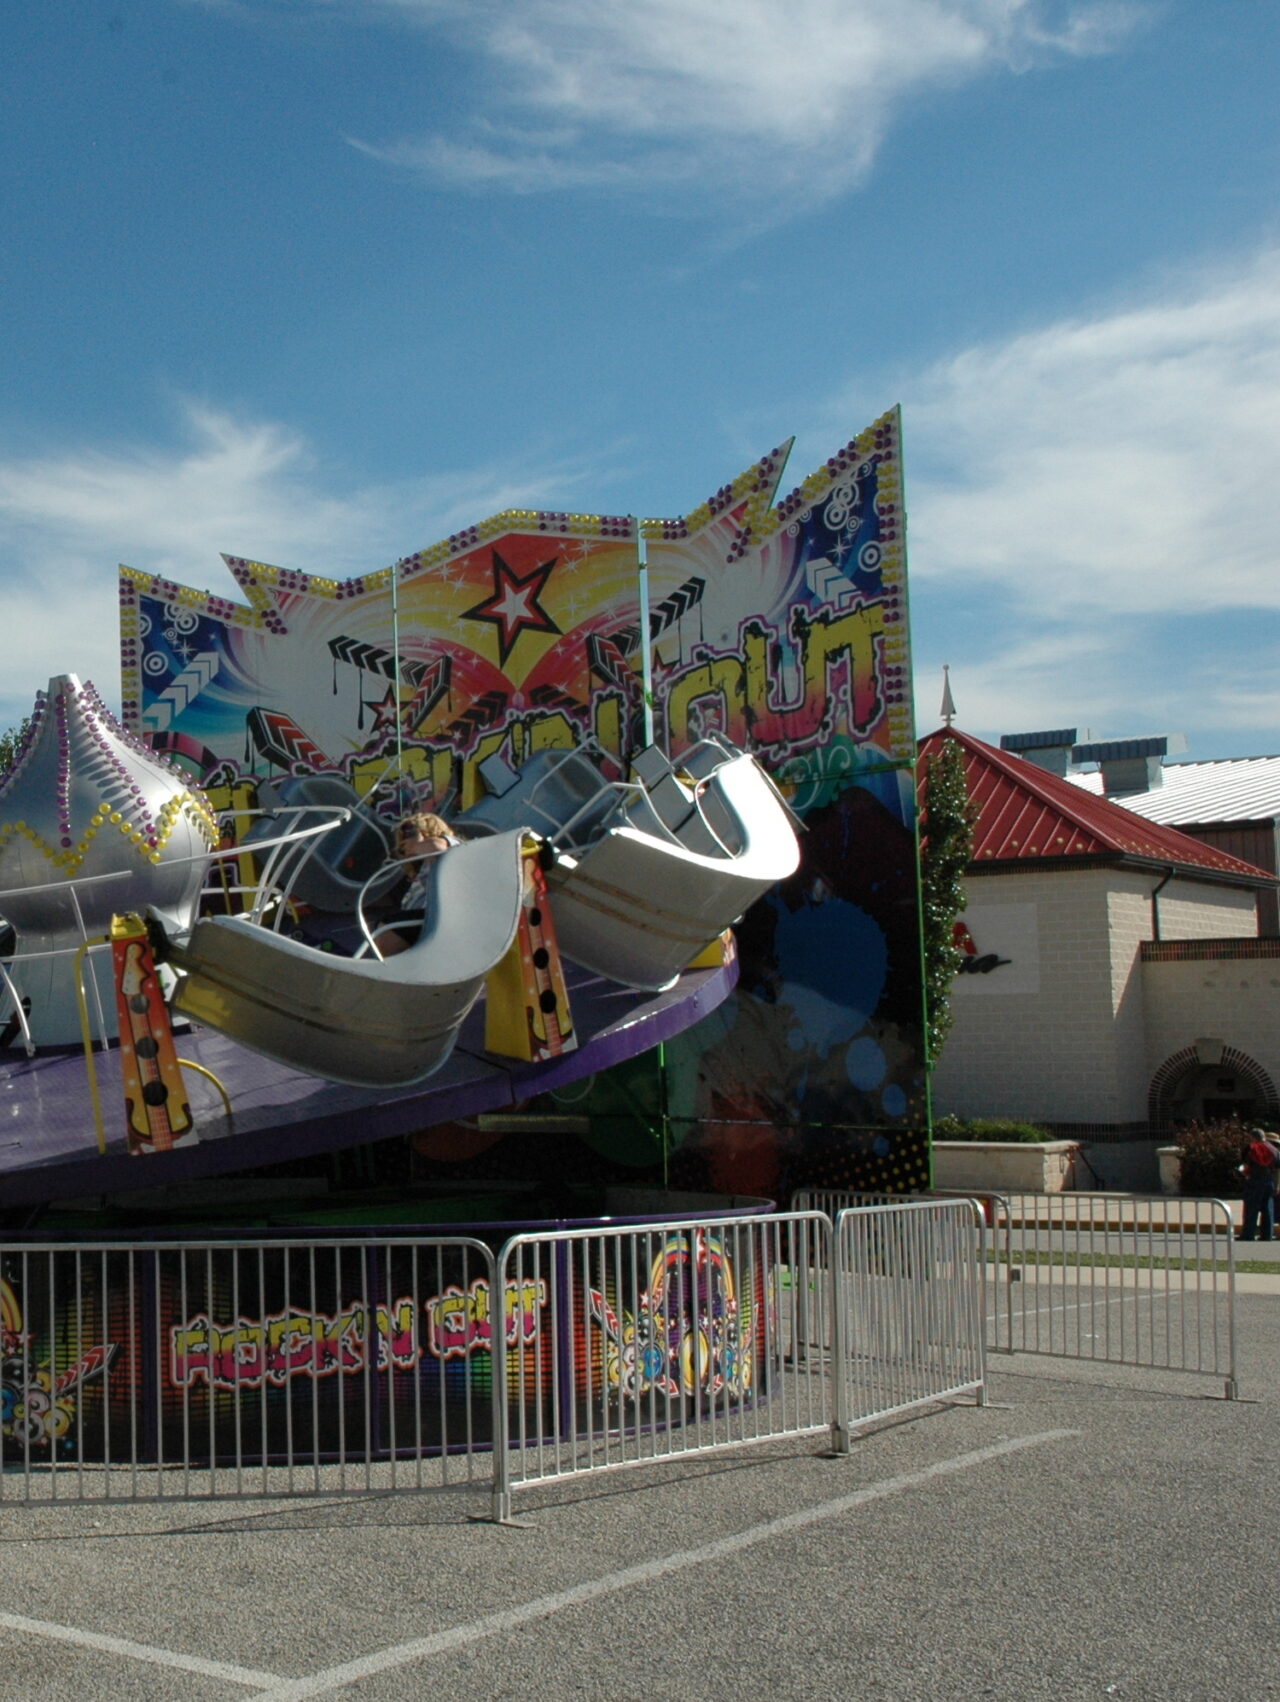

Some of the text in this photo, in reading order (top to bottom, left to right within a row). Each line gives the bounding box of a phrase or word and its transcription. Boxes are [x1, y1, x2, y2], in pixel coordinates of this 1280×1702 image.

[665, 601, 885, 752] OUT
[173, 1281, 547, 1388] ROCK'N OUT
